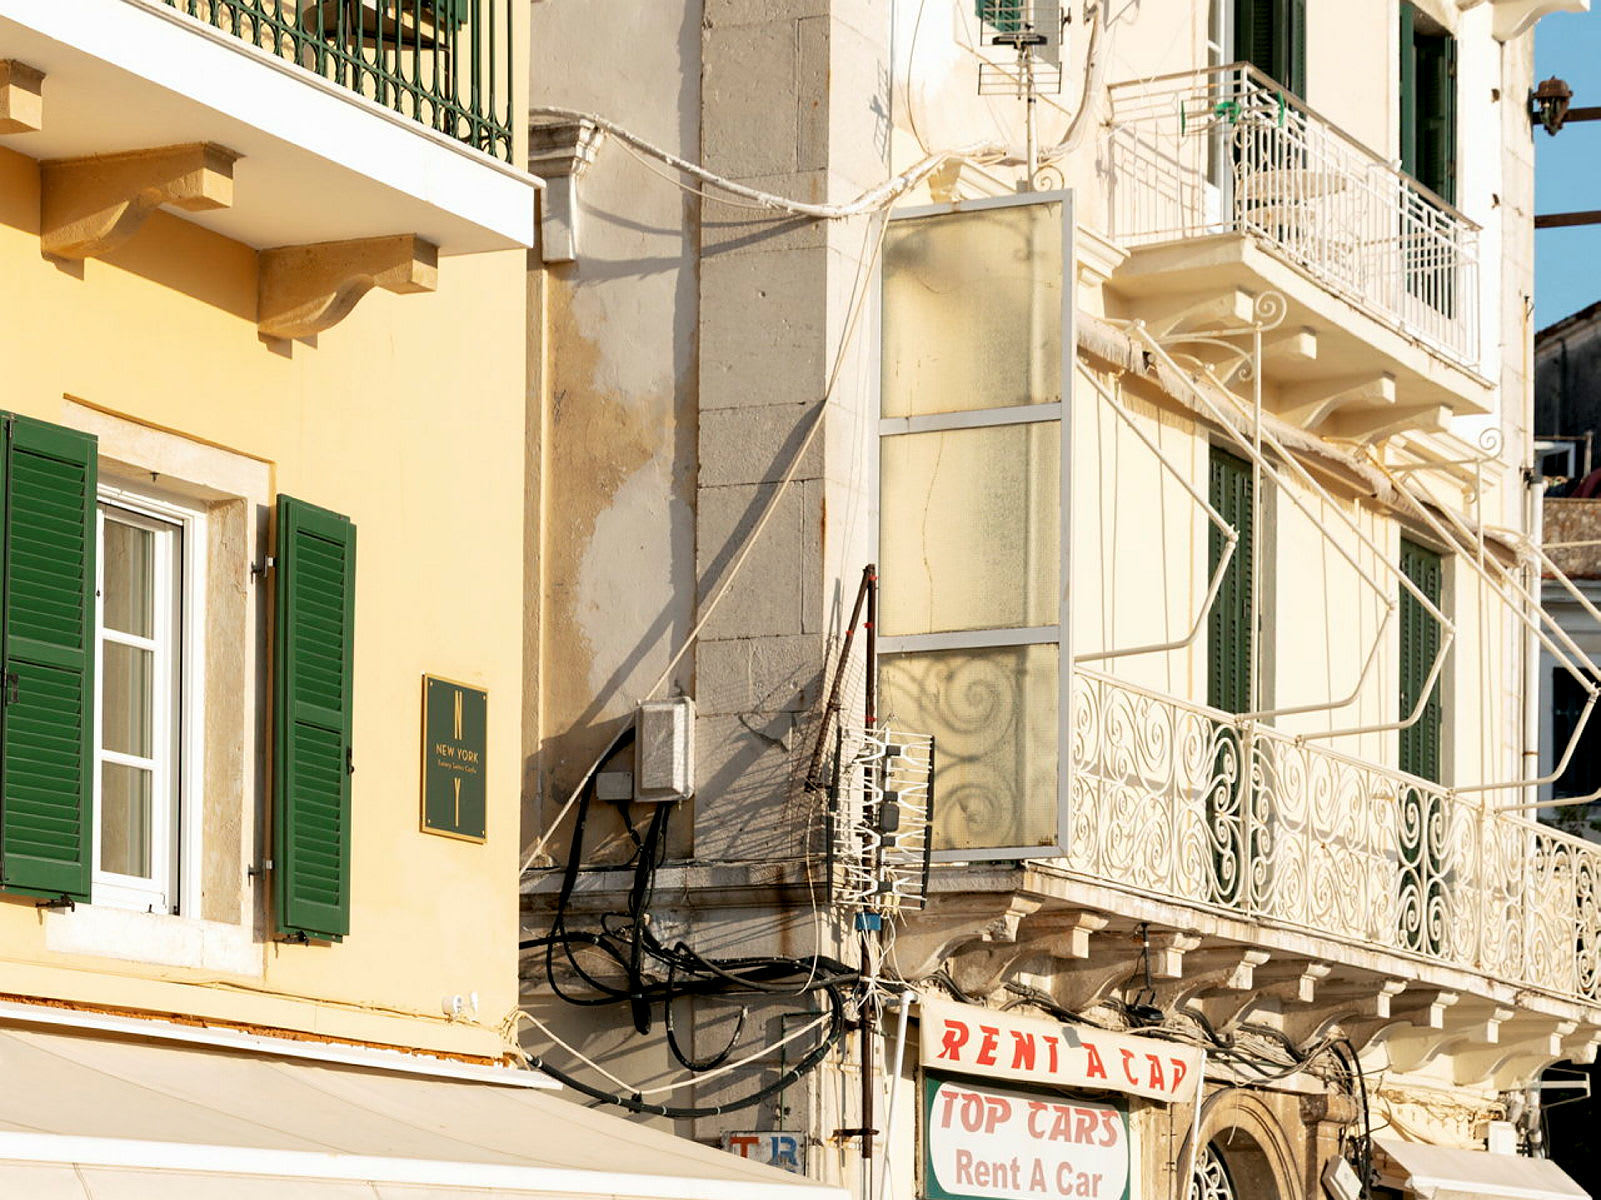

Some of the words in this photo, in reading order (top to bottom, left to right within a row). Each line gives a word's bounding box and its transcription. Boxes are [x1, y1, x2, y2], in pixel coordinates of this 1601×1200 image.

[454, 690, 463, 740] N
[436, 743, 455, 758] NEW
[457, 747, 479, 764] YORK
[454, 777, 461, 827] Y
[937, 1019, 1059, 1073] RENT
[1080, 1042, 1108, 1080] A
[941, 1089, 1012, 1134] TOP
[1027, 1101, 1119, 1147] CARS
[955, 1149, 1021, 1191] Rent
[1029, 1158, 1047, 1192] A
[1056, 1161, 1103, 1198] Car
